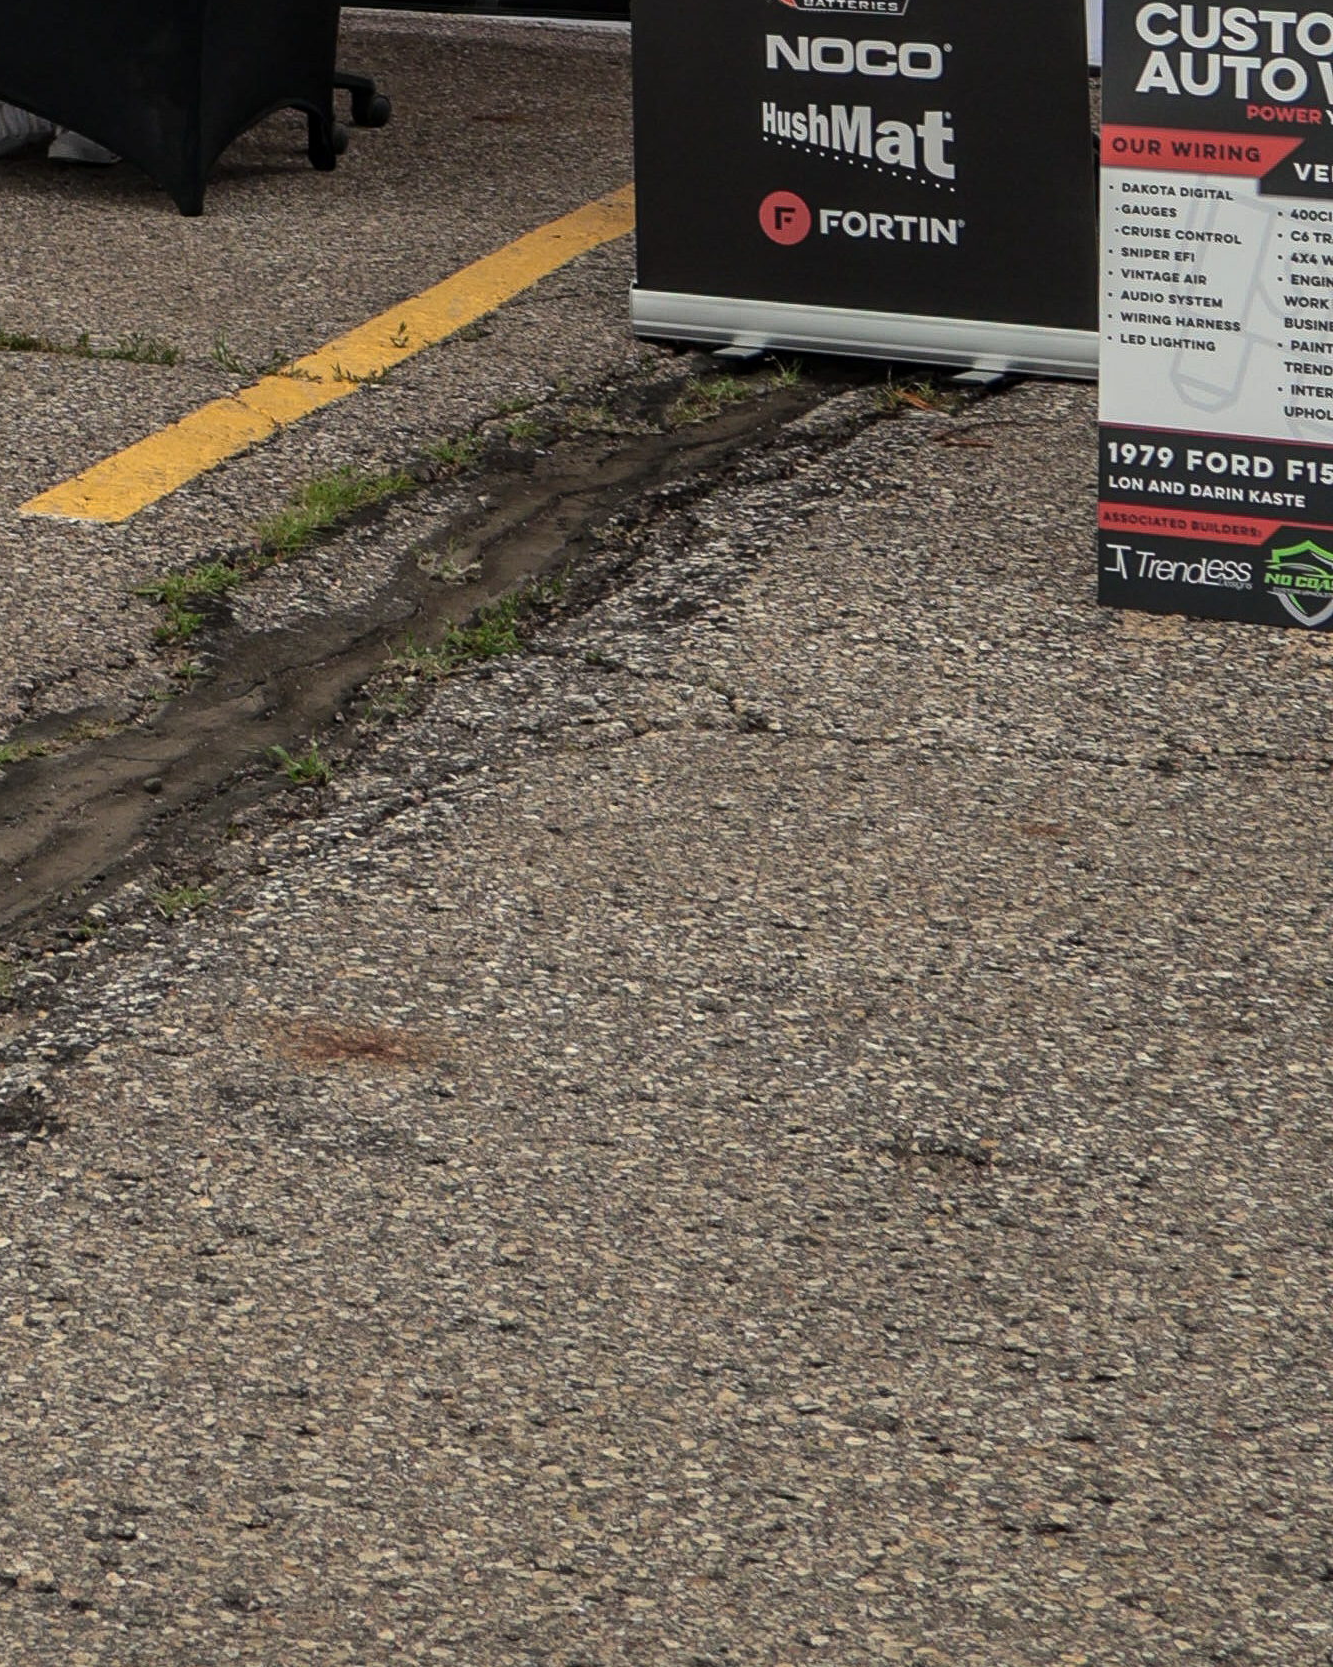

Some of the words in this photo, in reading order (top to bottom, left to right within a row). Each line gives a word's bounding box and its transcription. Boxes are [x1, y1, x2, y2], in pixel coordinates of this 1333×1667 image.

[766, 34, 943, 79] NOCO
[1135, 50, 1308, 102] AUTO
[1246, 105, 1322, 125] POWER
[762, 102, 956, 179] HushMat
[1112, 137, 1162, 156] OUR
[1172, 140, 1261, 163] WIRING
[1122, 183, 1176, 197] DAKOTA
[1180, 187, 1234, 201] DIGITAL
[1121, 204, 1177, 218] GAUGES
[774, 206, 796, 230] F
[819, 209, 958, 245] FORTIN
[1121, 225, 1171, 239] CRUISE
[1175, 229, 1242, 245] CONTROL
[1291, 231, 1310, 242] C6
[1121, 247, 1170, 261] SNIPER
[1174, 251, 1195, 262] EFI
[1291, 253, 1318, 265] 4X4
[1121, 269, 1181, 284] VINTAGE
[1184, 273, 1207, 285] AIR
[1120, 290, 1164, 304] AUDIO
[1169, 295, 1223, 308] SYSTEM
[1284, 295, 1330, 309] WORK
[1120, 312, 1172, 326] WIRING
[1176, 317, 1241, 331] HARNESS
[1120, 333, 1147, 346] LED
[1150, 337, 1216, 352] LIGHTING
[1107, 442, 1174, 468] 1979
[1186, 449, 1275, 479] FORD
[1108, 475, 1143, 492] LON
[1148, 480, 1185, 496] AND
[1190, 484, 1244, 502] DARIN
[1249, 489, 1306, 508] KASTE
[1103, 511, 1187, 531] ASSOCIATED
